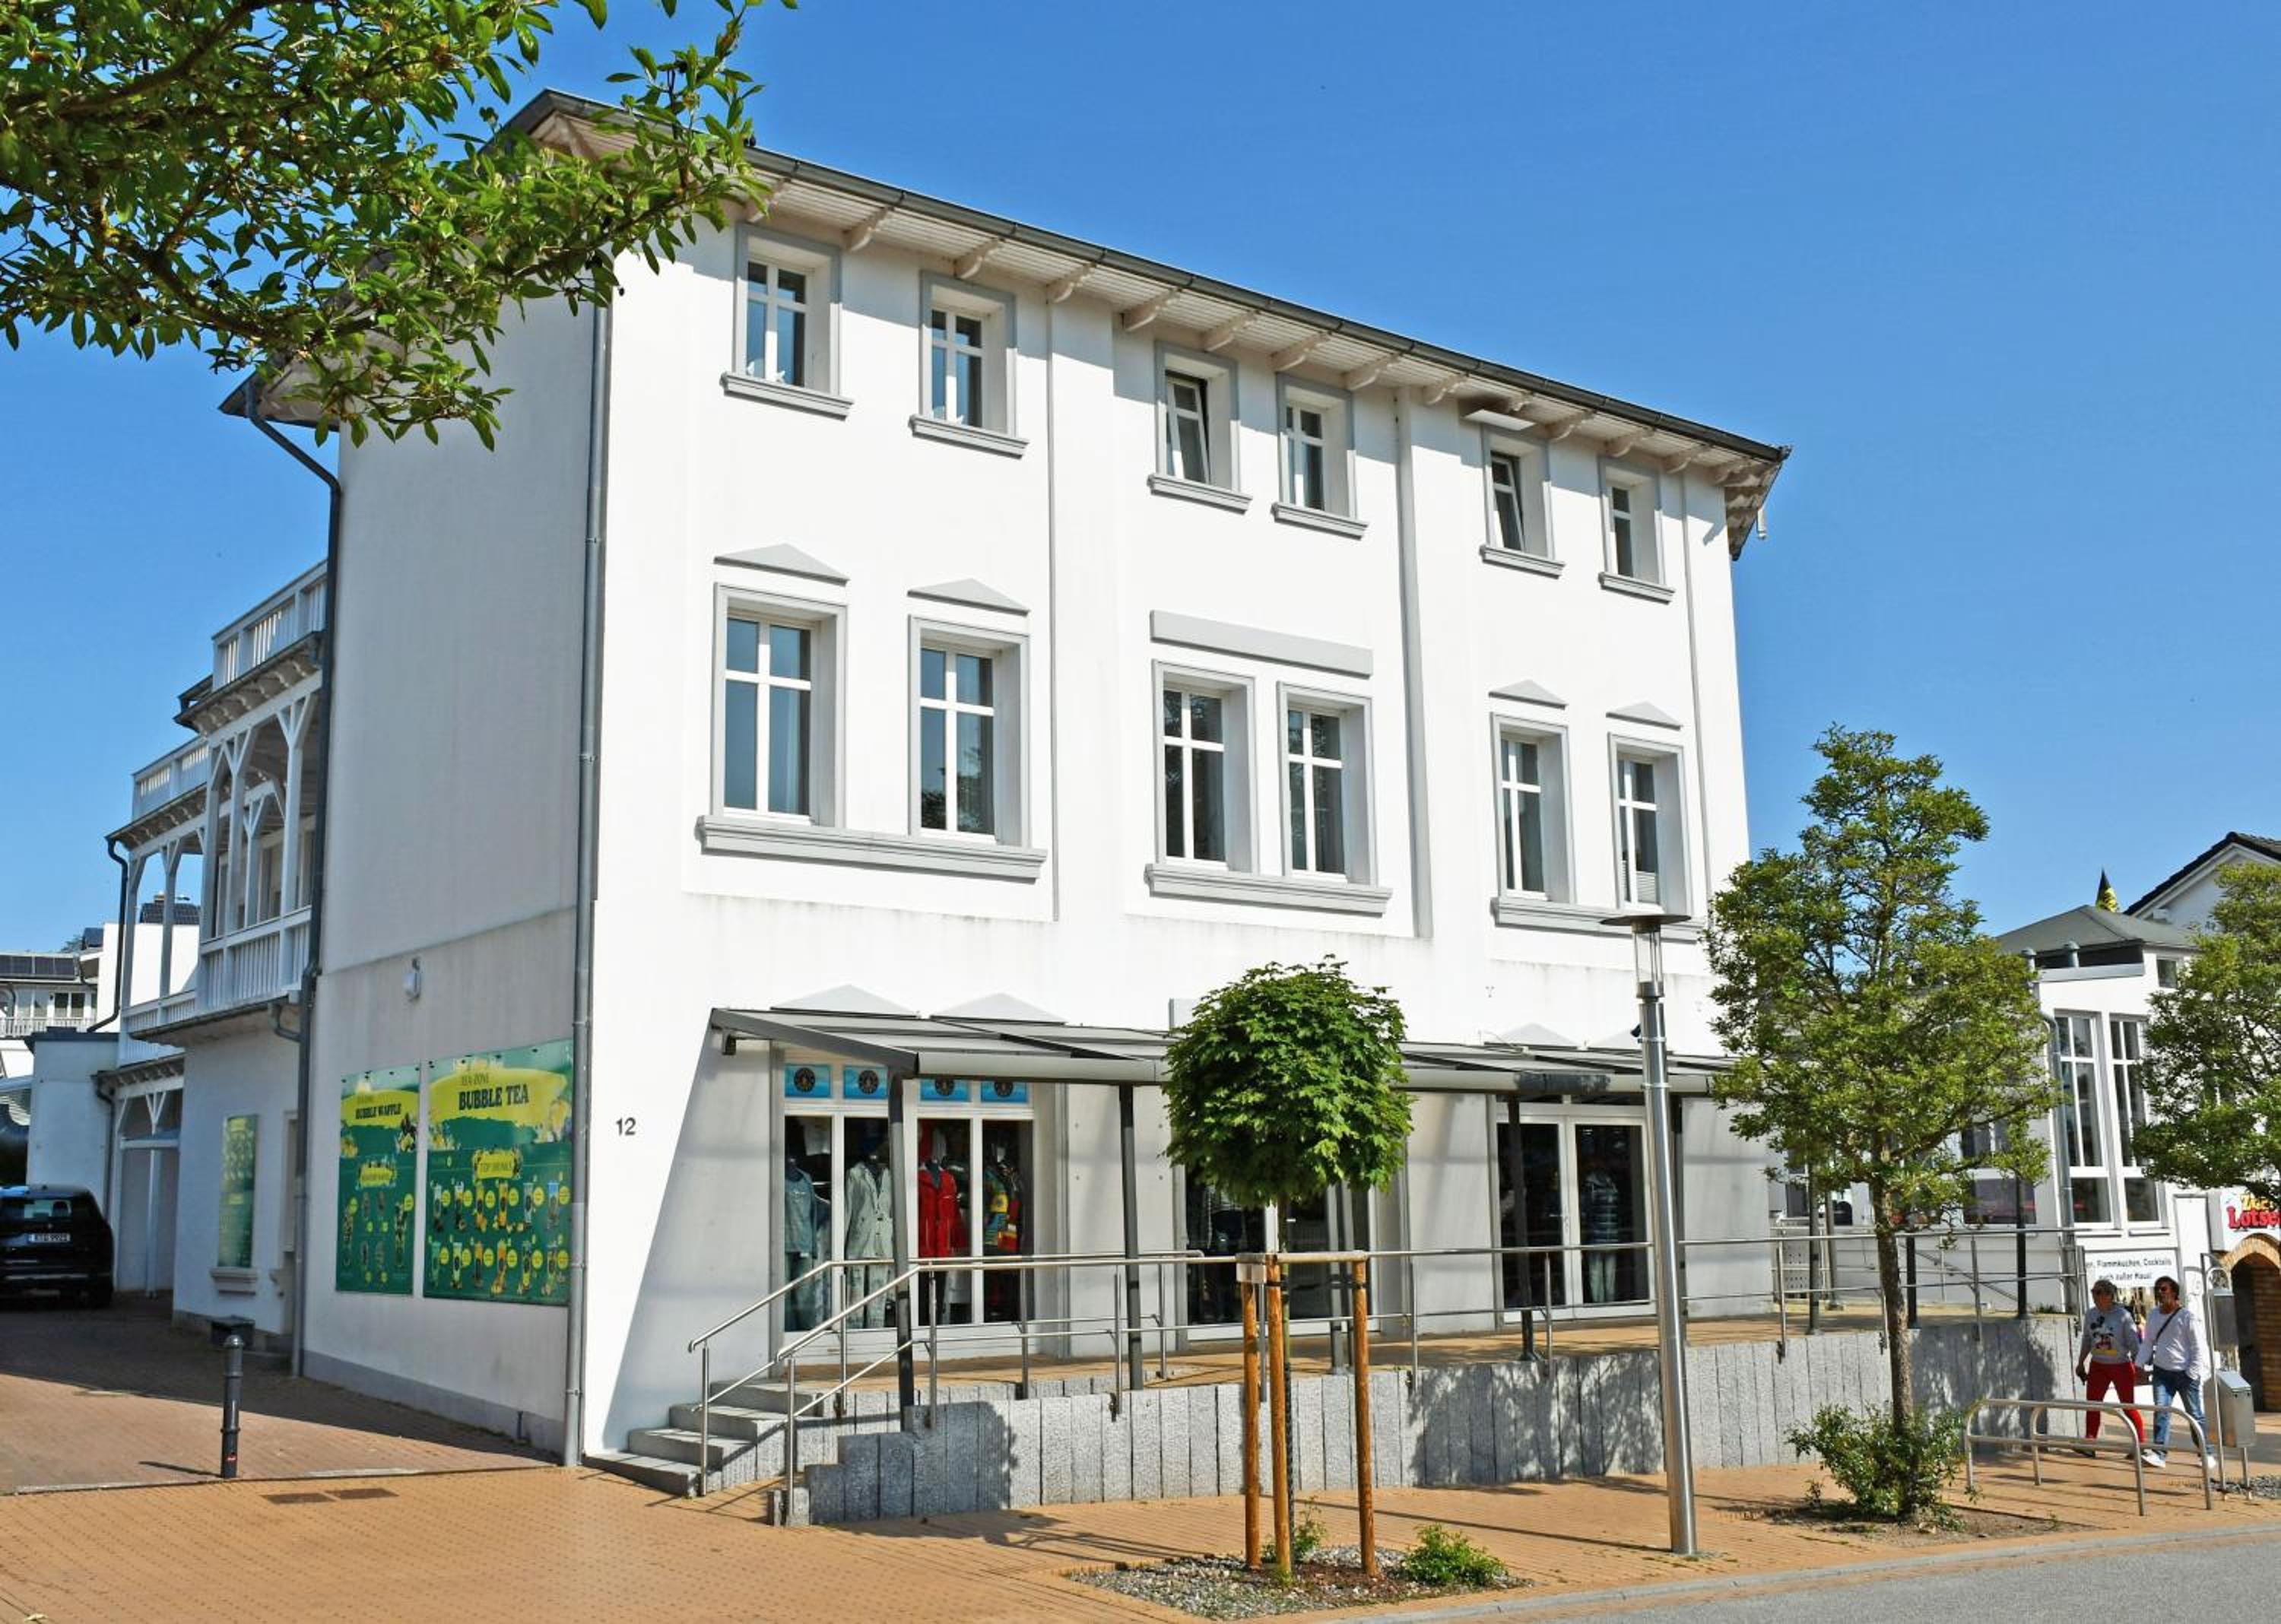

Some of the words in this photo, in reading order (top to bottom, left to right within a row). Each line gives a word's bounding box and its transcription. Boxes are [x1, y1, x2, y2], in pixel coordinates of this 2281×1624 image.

[458, 1087, 503, 1111] BUBBLE
[506, 1083, 530, 1105] TEA
[355, 1106, 376, 1120] BUBBLE
[616, 1117, 636, 1137] 12
